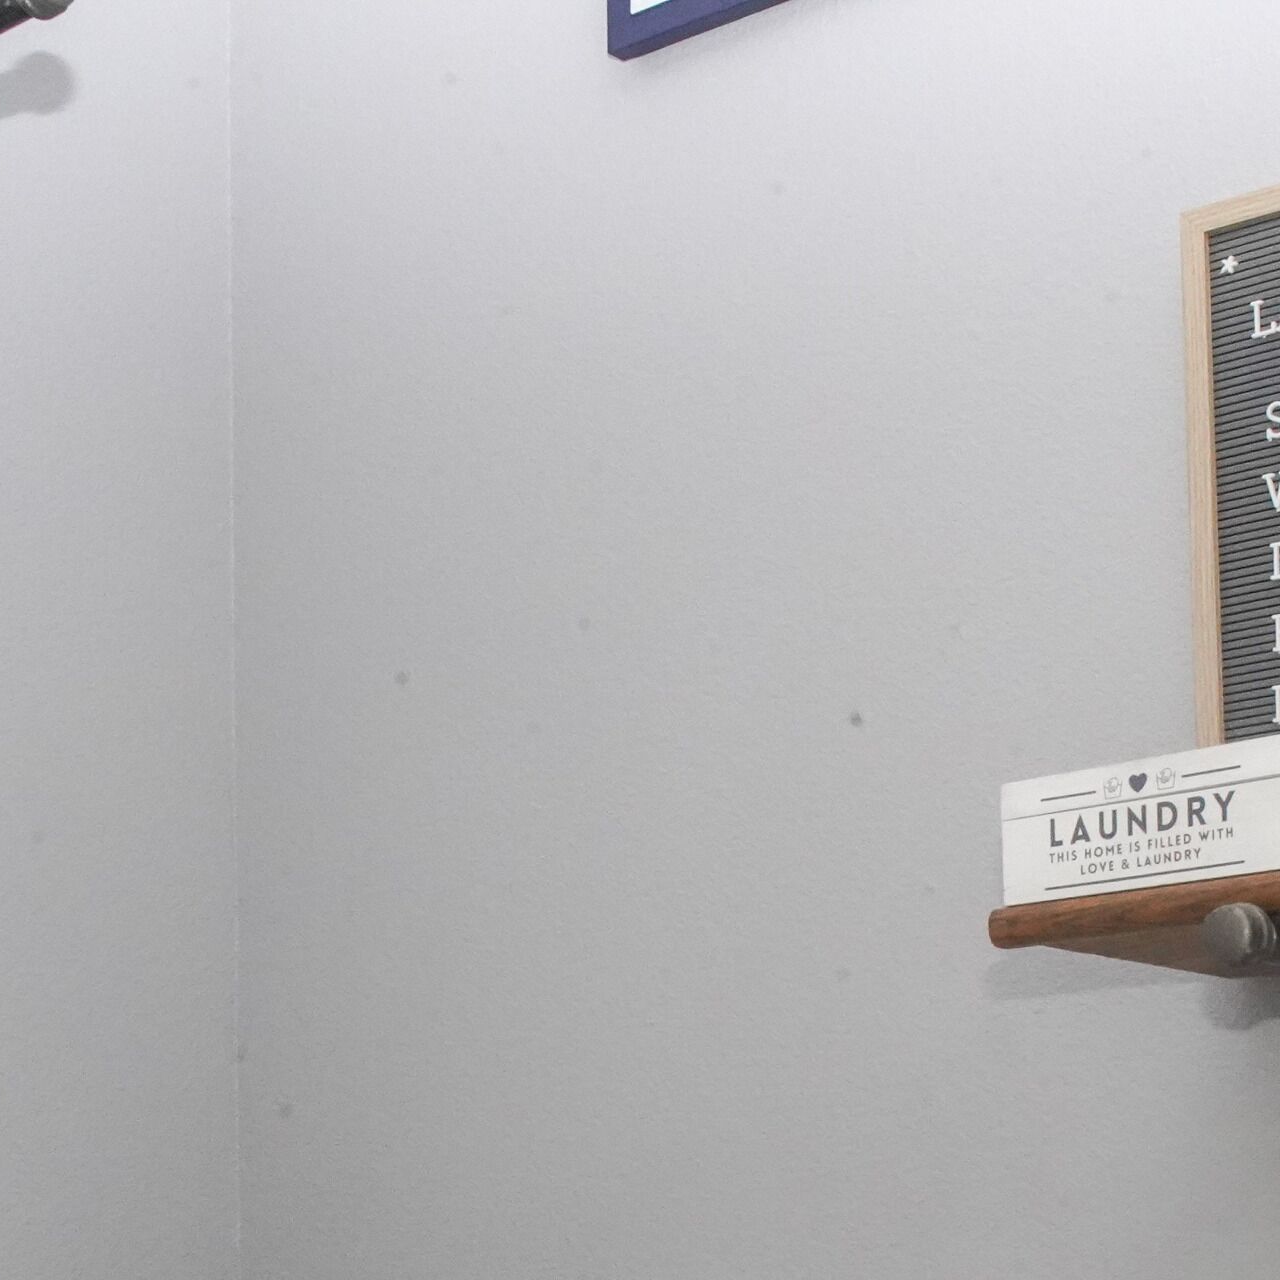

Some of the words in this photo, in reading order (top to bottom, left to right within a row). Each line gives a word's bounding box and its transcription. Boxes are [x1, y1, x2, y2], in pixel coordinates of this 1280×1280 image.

[1049, 791, 1236, 847] LAUNDRY
[1049, 850, 1078, 864] THIS
[1084, 845, 1122, 860] HOME
[1129, 841, 1141, 853] IS
[1147, 834, 1192, 851] FILLED
[1199, 827, 1235, 842] WITH
[1080, 861, 1114, 876] LOVE
[1121, 858, 1130, 869] &
[1136, 847, 1202, 867] LAUNDRY
